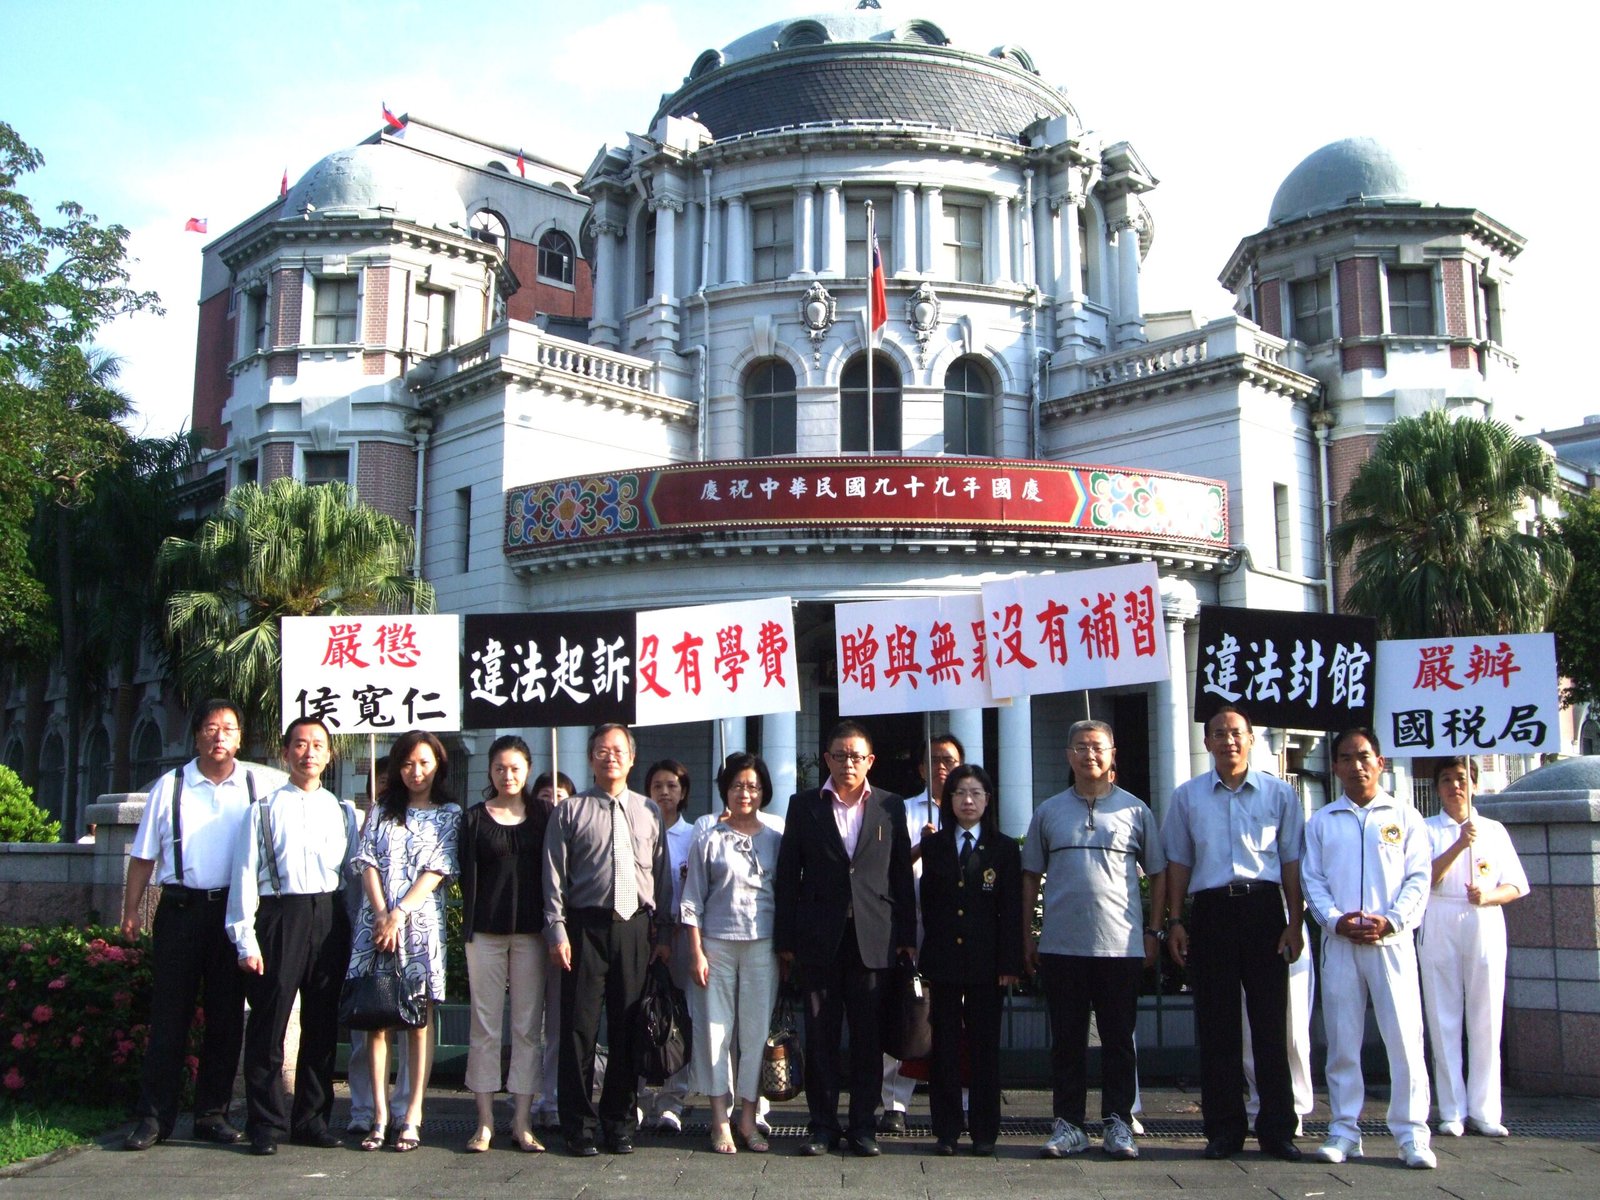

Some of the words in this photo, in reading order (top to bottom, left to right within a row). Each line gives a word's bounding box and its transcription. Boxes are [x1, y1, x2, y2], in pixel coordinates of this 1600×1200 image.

[700, 475, 1043, 502] 慶祝中華民國九十九年國慶
[320, 622, 421, 669] 嚴懲
[1412, 642, 1521, 692] 嚴辦
[470, 635, 631, 706] 違法起訴
[1203, 632, 1371, 709] 違法封館
[295, 684, 447, 728] 侯寬仁
